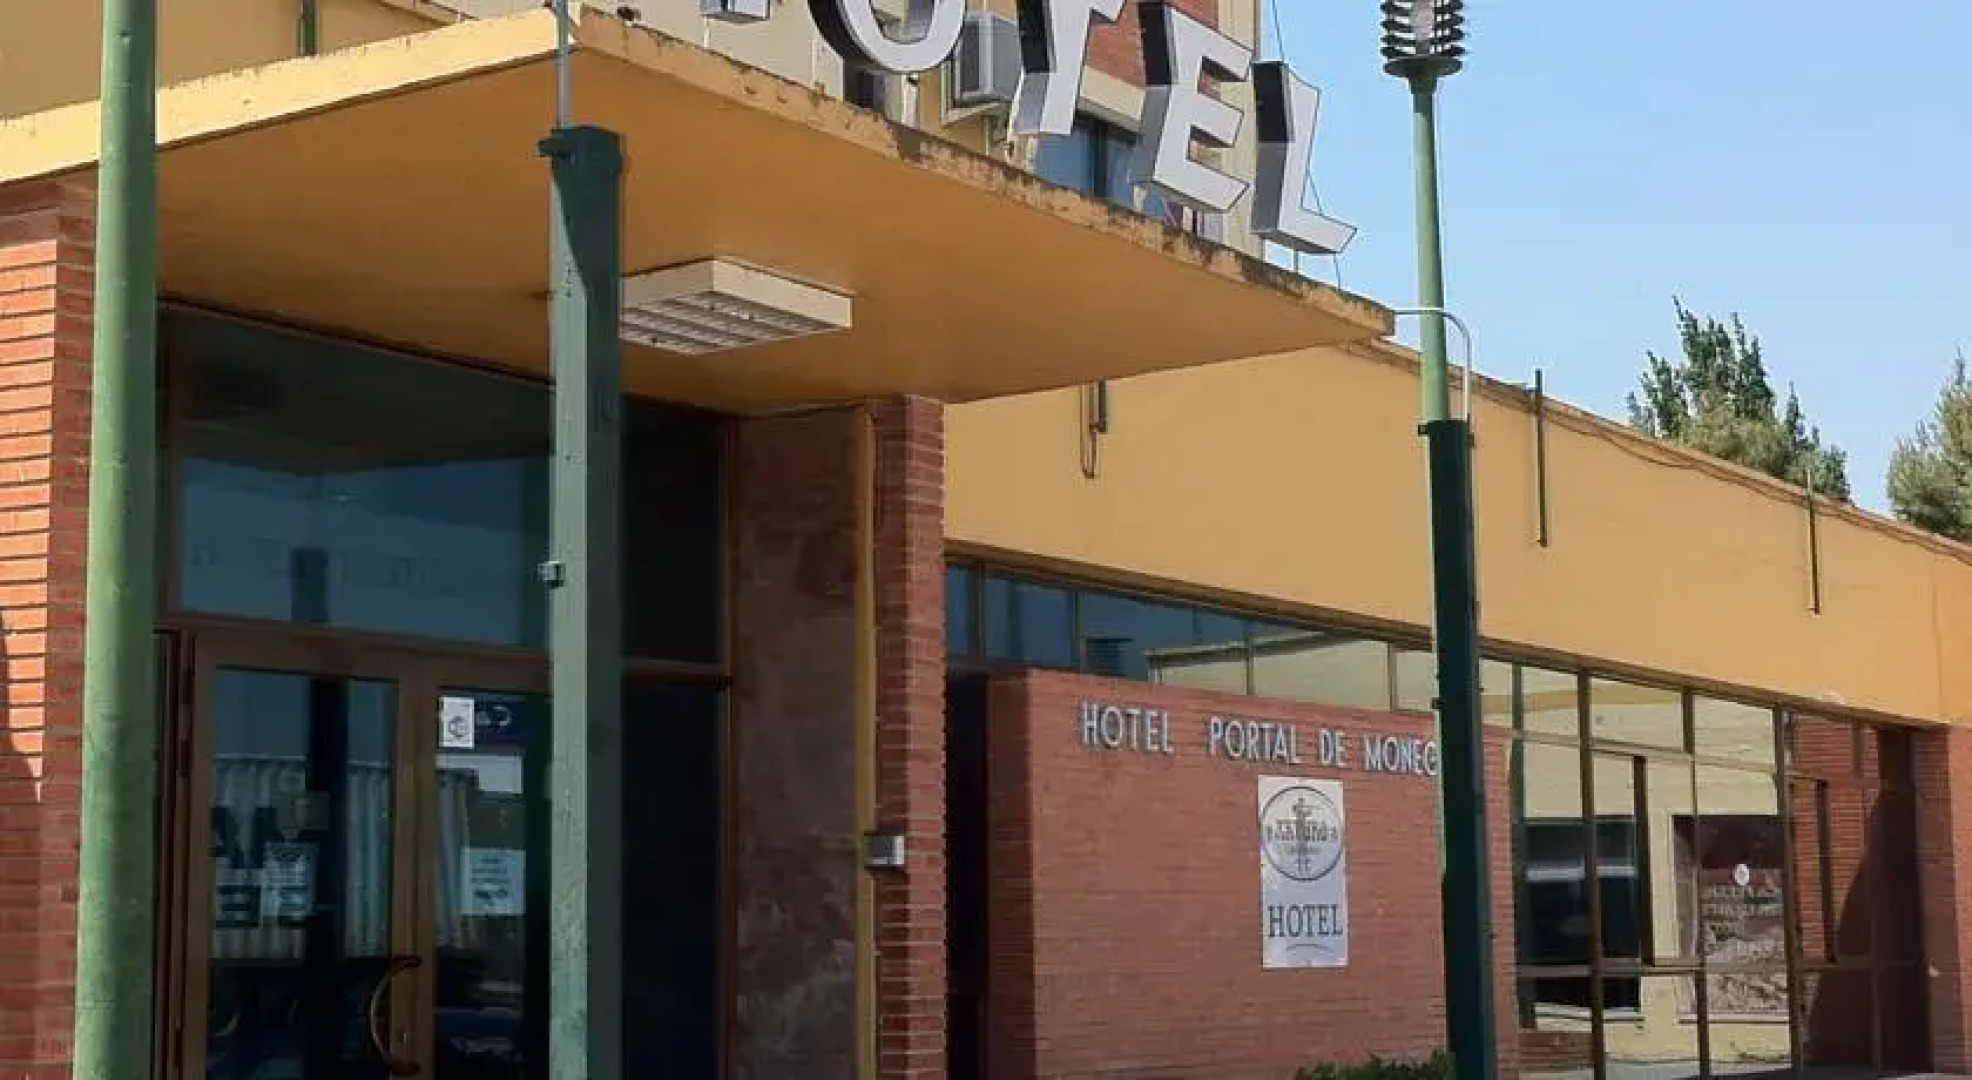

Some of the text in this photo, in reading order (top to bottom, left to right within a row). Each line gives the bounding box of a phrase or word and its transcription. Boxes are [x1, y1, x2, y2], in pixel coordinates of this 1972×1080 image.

[702, 0, 1357, 253] TEL
[1082, 702, 1174, 754] HOTEL
[1209, 716, 1303, 764] PORTAL
[1318, 728, 1348, 768] DE
[1267, 904, 1343, 937] HOTEL
